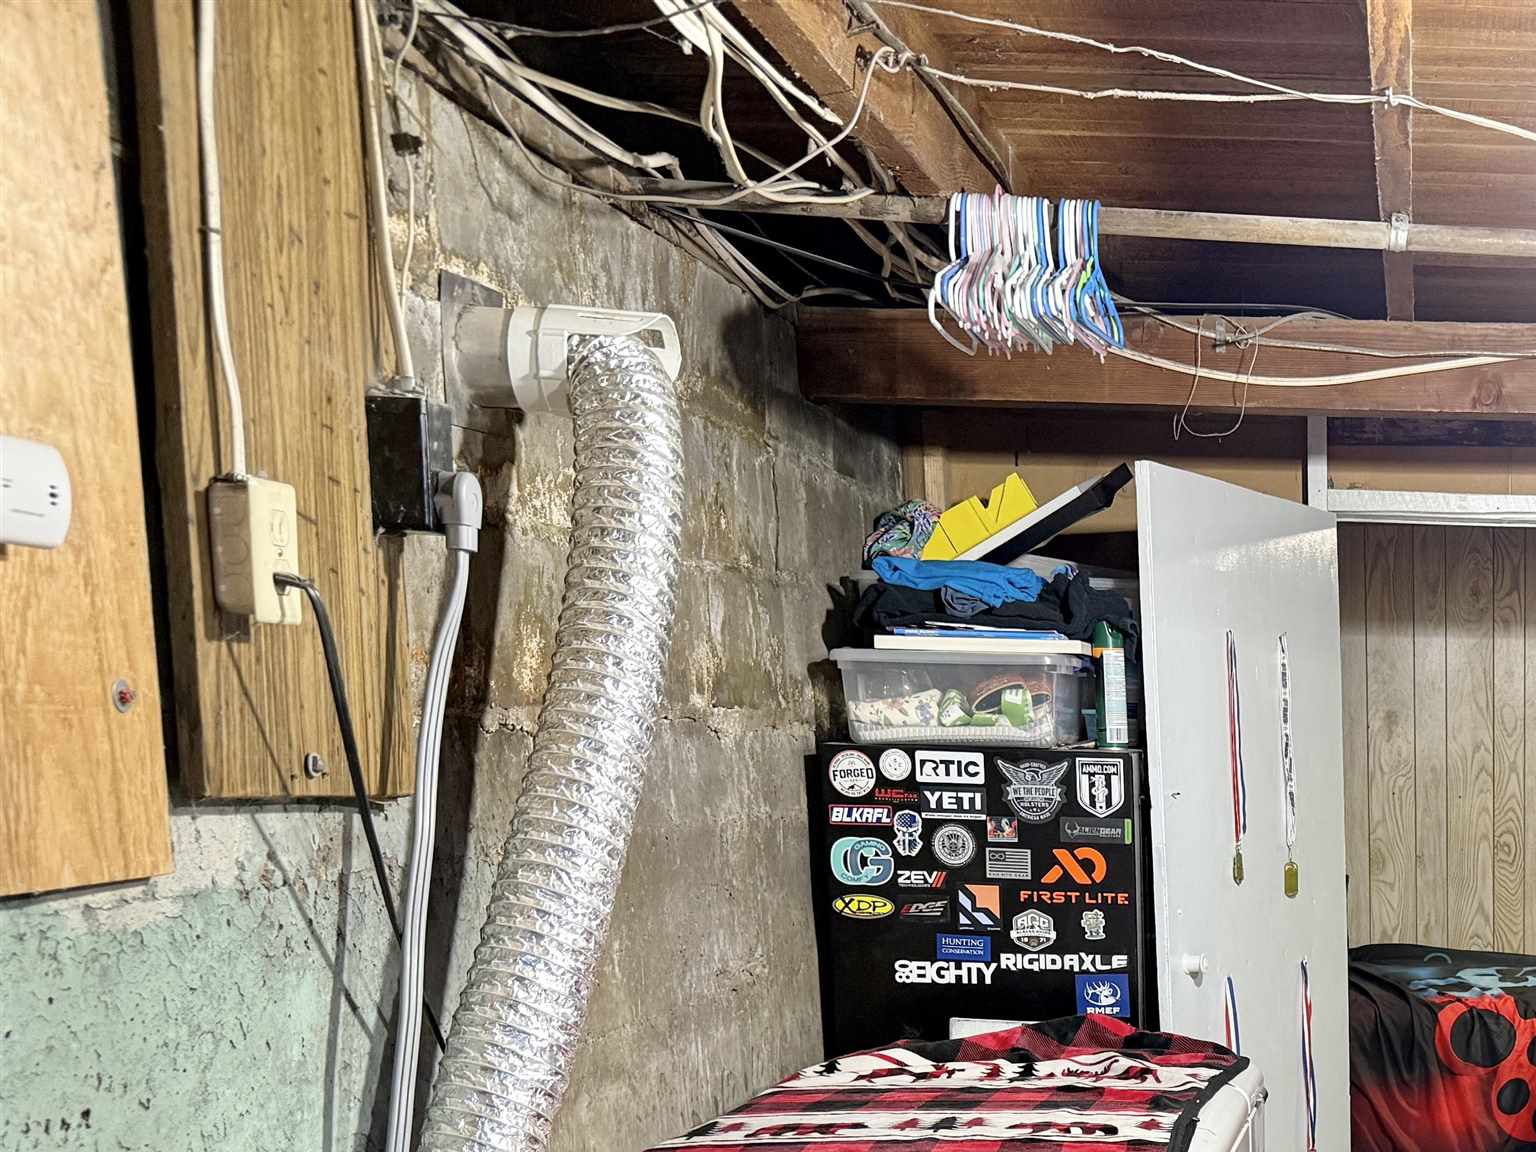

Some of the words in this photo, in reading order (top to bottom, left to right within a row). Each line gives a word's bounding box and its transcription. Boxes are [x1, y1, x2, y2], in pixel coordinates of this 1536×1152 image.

[832, 767, 875, 782] FORGED
[919, 759, 981, 778] RTIC
[1082, 763, 1118, 775] AMMO.COM
[1012, 786, 1023, 796] WE
[1023, 786, 1033, 796] THE
[1034, 786, 1055, 797] PEOPLE
[923, 790, 982, 811] YETI
[854, 839, 886, 851] GAMING
[897, 870, 937, 883] ZEV
[1020, 890, 1080, 904] FIRST
[1084, 892, 1129, 905] LITE
[838, 897, 888, 915] XDP
[942, 937, 984, 947] HUNTING
[942, 948, 984, 956] CONSERVATION
[1086, 1006, 1121, 1015] RMEF
